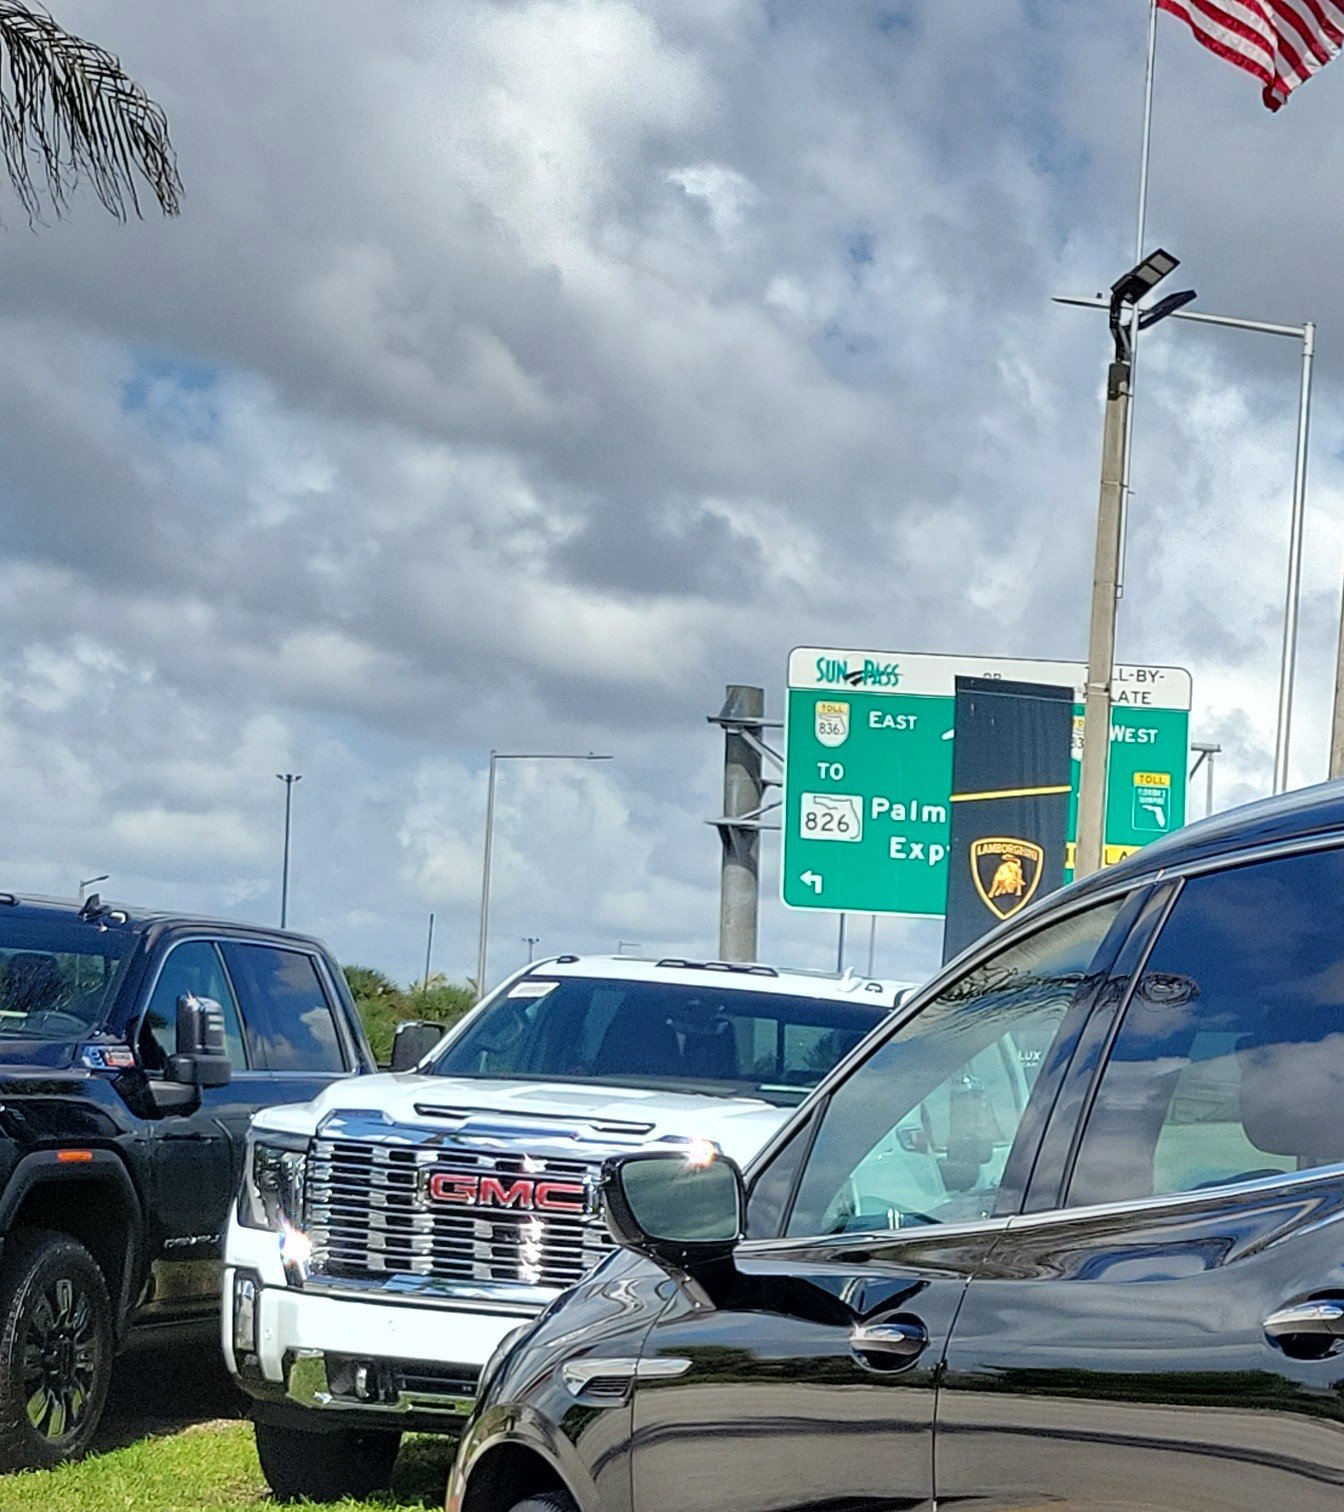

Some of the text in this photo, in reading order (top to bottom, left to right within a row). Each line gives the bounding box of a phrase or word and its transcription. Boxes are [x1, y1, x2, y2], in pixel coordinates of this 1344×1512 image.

[816, 657, 900, 686] SUN PASS
[821, 704, 844, 713] TOLL
[819, 722, 841, 736] 836
[869, 711, 917, 730] EAST
[1110, 725, 1158, 743] WEST
[817, 762, 844, 780] TO
[1138, 774, 1166, 785] TOLL
[805, 812, 850, 832] 826
[889, 836, 950, 866] Exp
[430, 1173, 585, 1213] GMC
